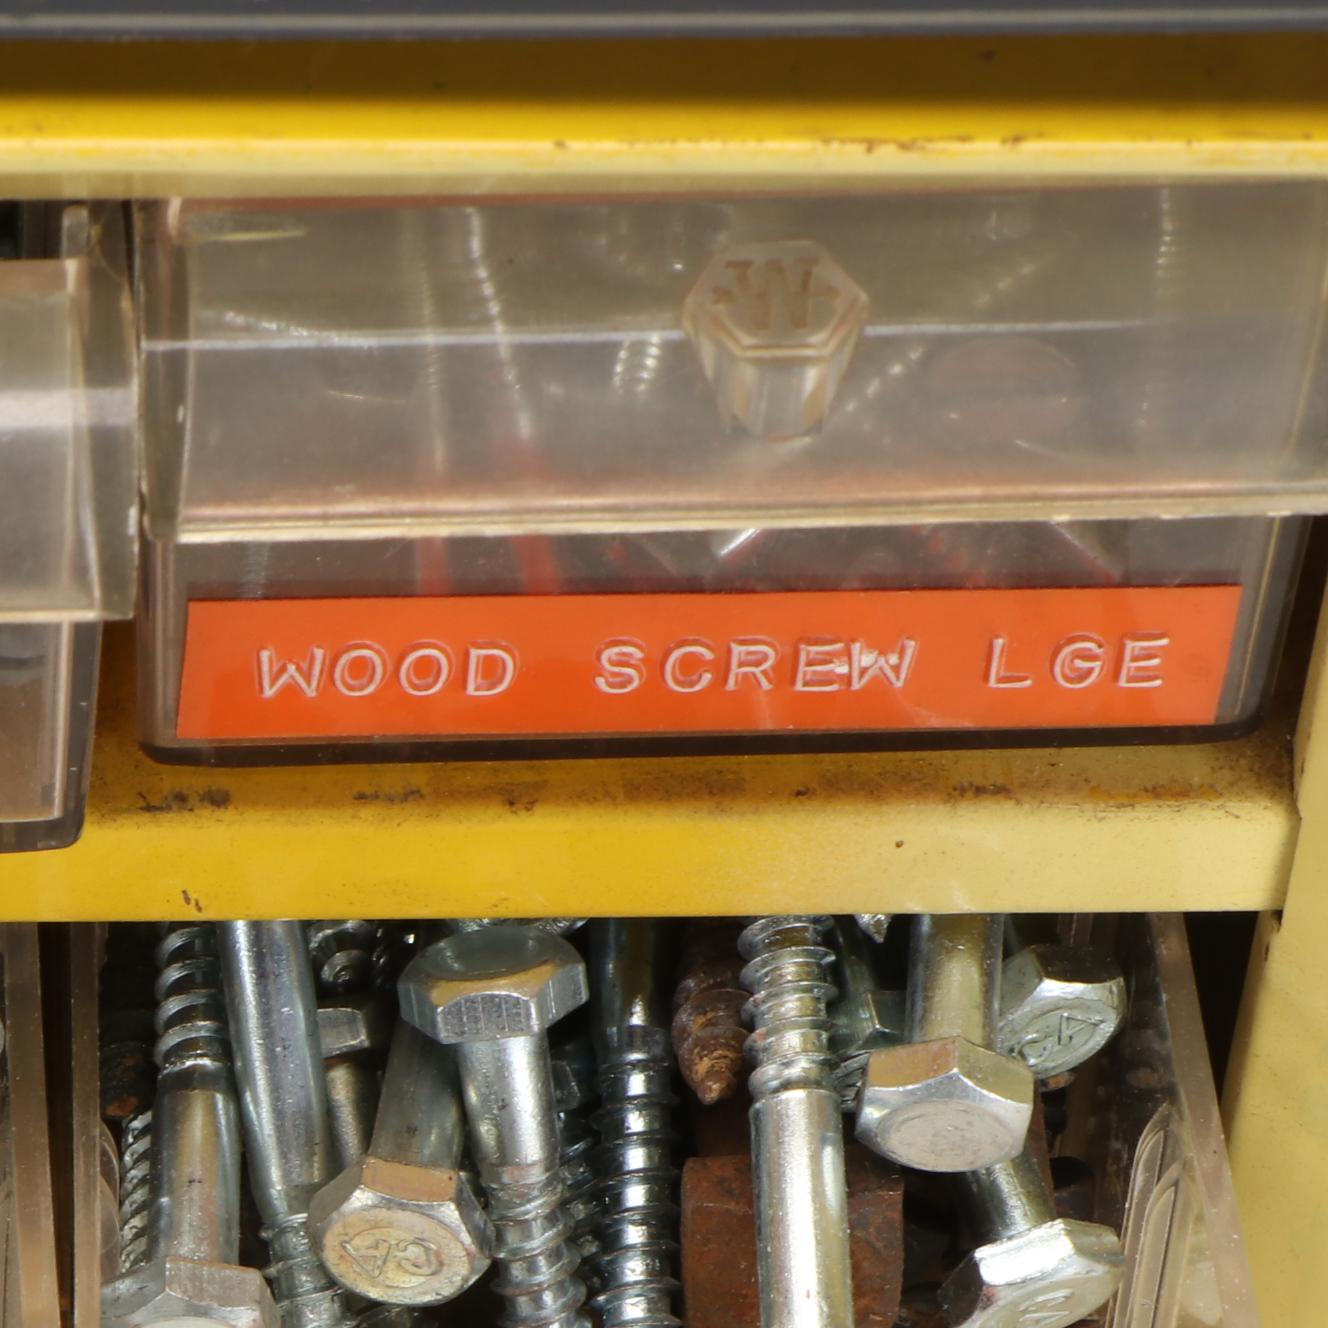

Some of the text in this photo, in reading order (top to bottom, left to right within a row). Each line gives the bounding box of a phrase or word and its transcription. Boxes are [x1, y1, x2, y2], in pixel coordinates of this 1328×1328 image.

[257, 634, 1171, 700] WOOD SCREW LGE
